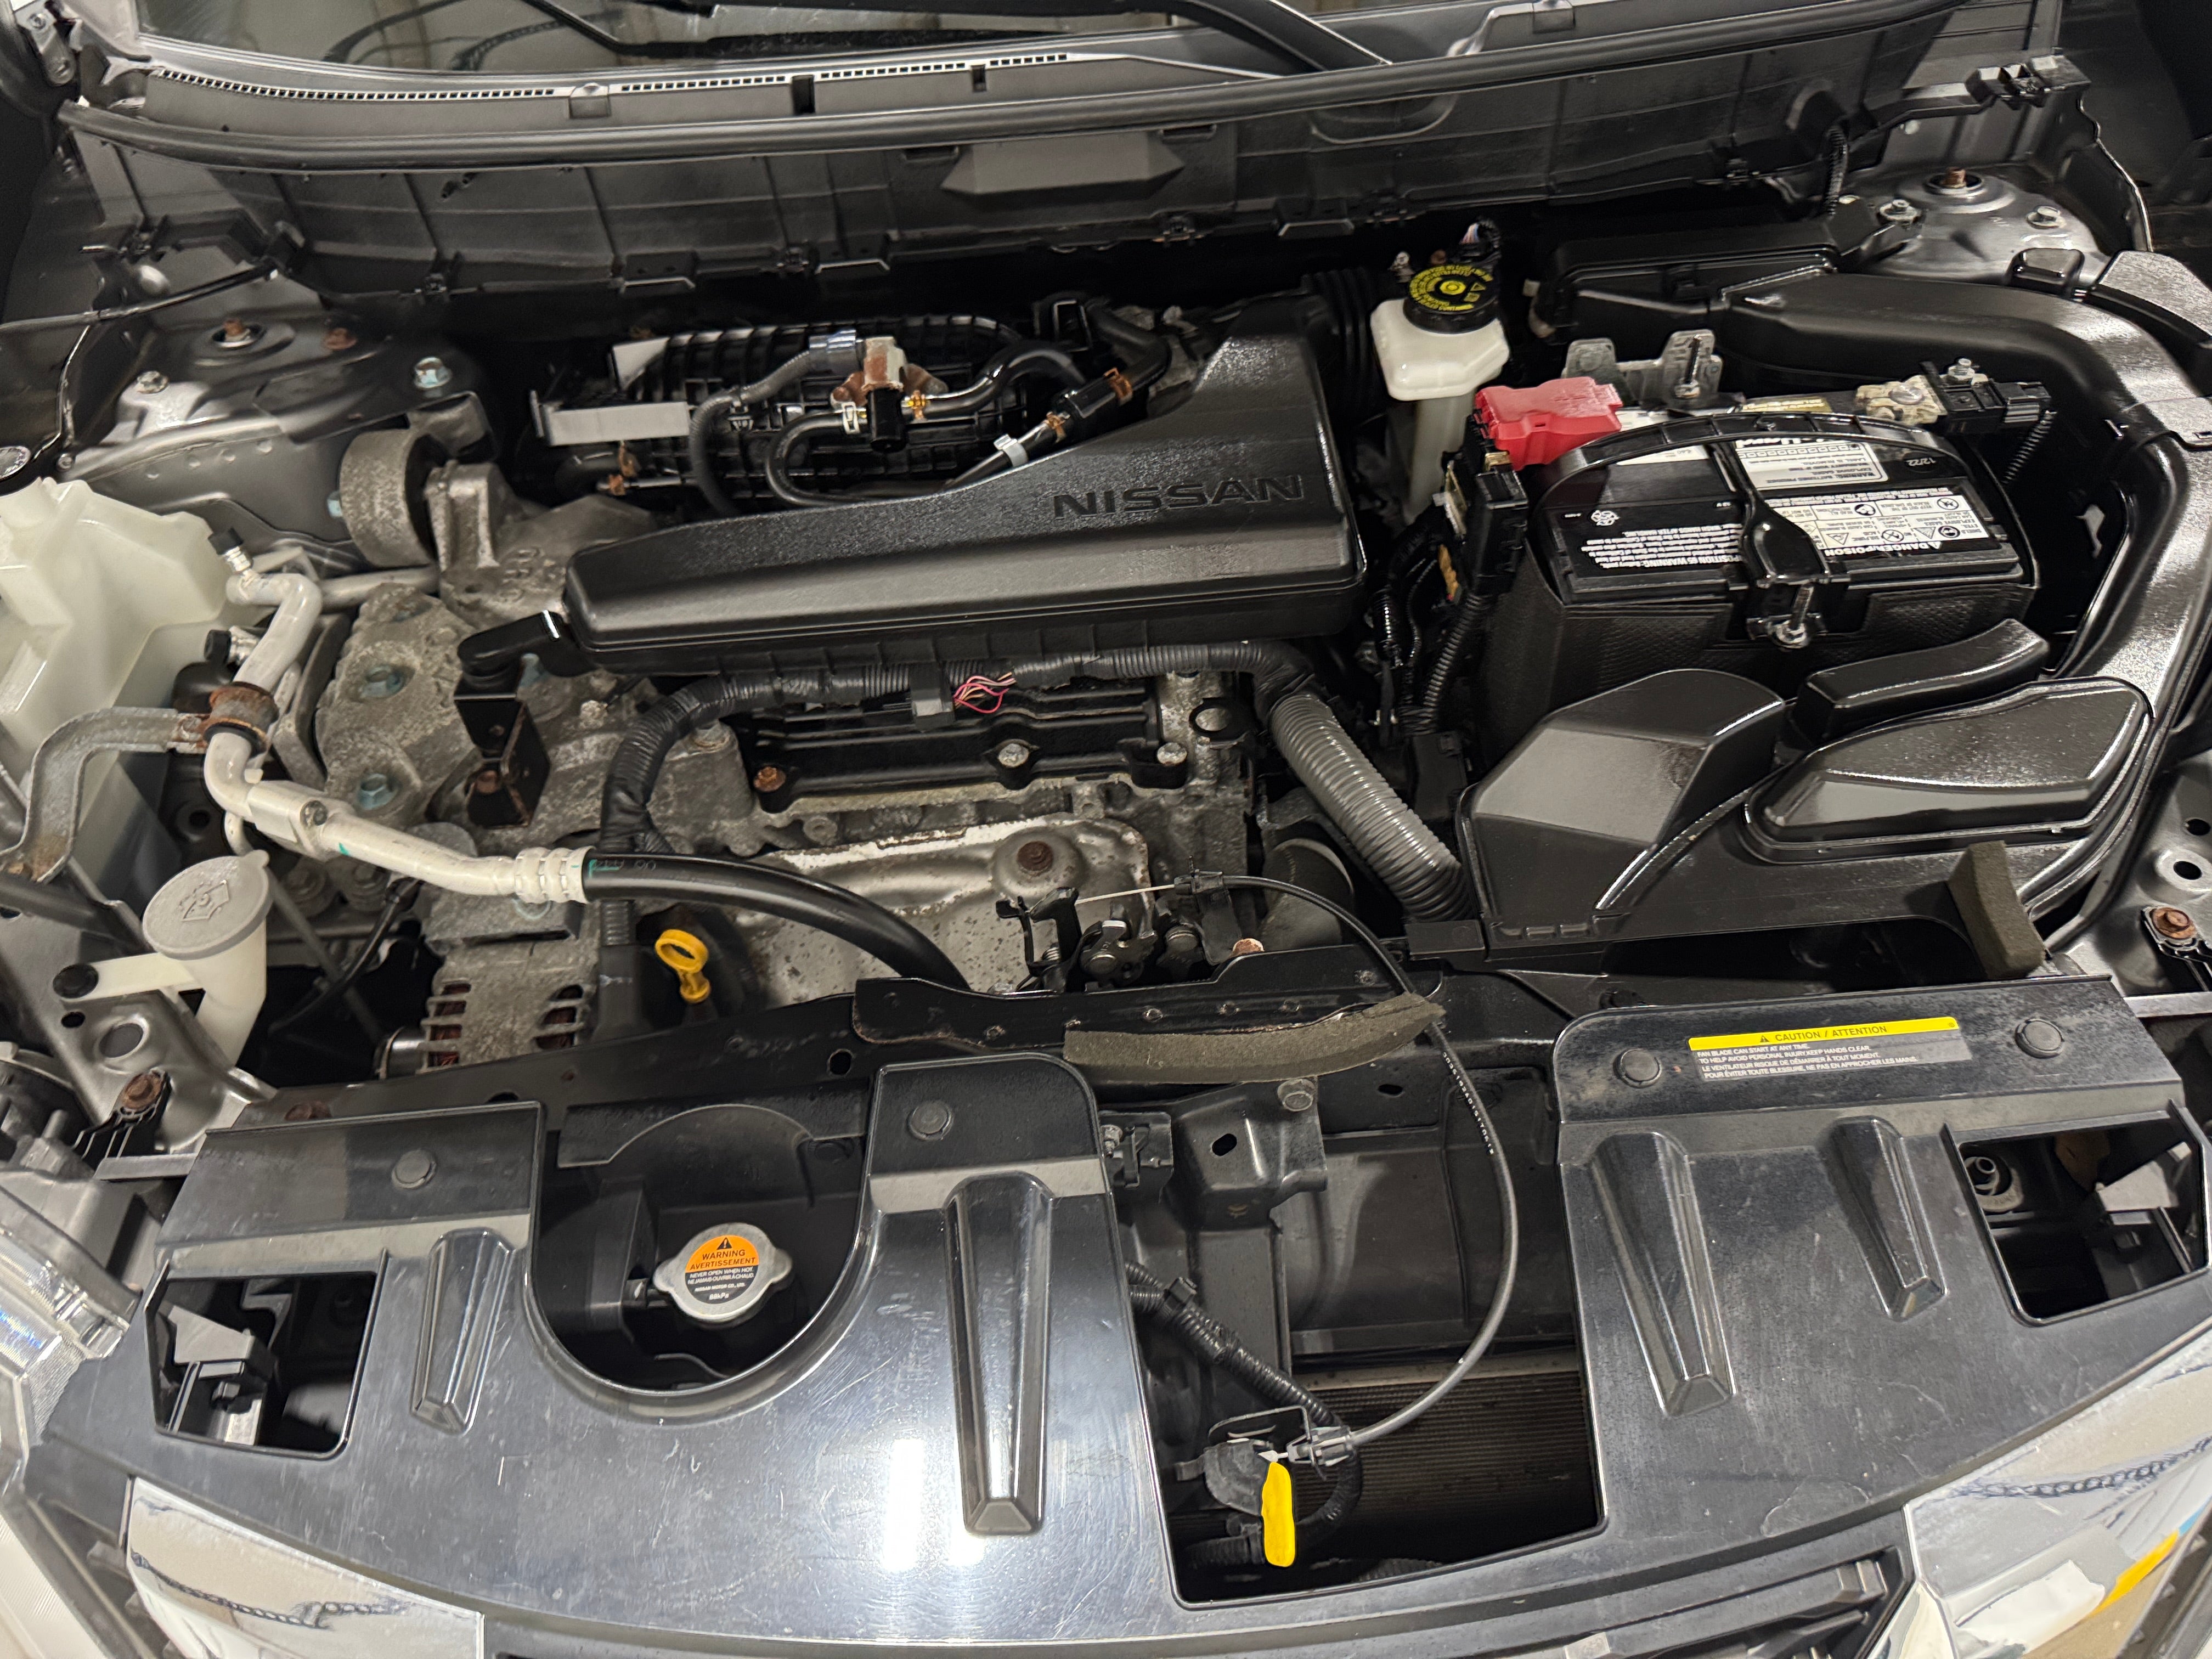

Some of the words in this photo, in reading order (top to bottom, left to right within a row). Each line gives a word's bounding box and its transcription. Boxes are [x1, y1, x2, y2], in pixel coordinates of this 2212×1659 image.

[1053, 475, 1304, 520] NISSAN
[1774, 1031, 1820, 1041] CAUTION
[1832, 1025, 1887, 1037] ATTENTION
[1748, 1052, 1784, 1060] PERSONAL
[1711, 1062, 1754, 1071] VENTILATEUR
[1724, 1068, 1747, 1077] ÉVITER
[1840, 1059, 1882, 1068] APPROCHER
[702, 1249, 746, 1260] WARNING
[689, 1256, 756, 1270] AVERTISSEMENT
